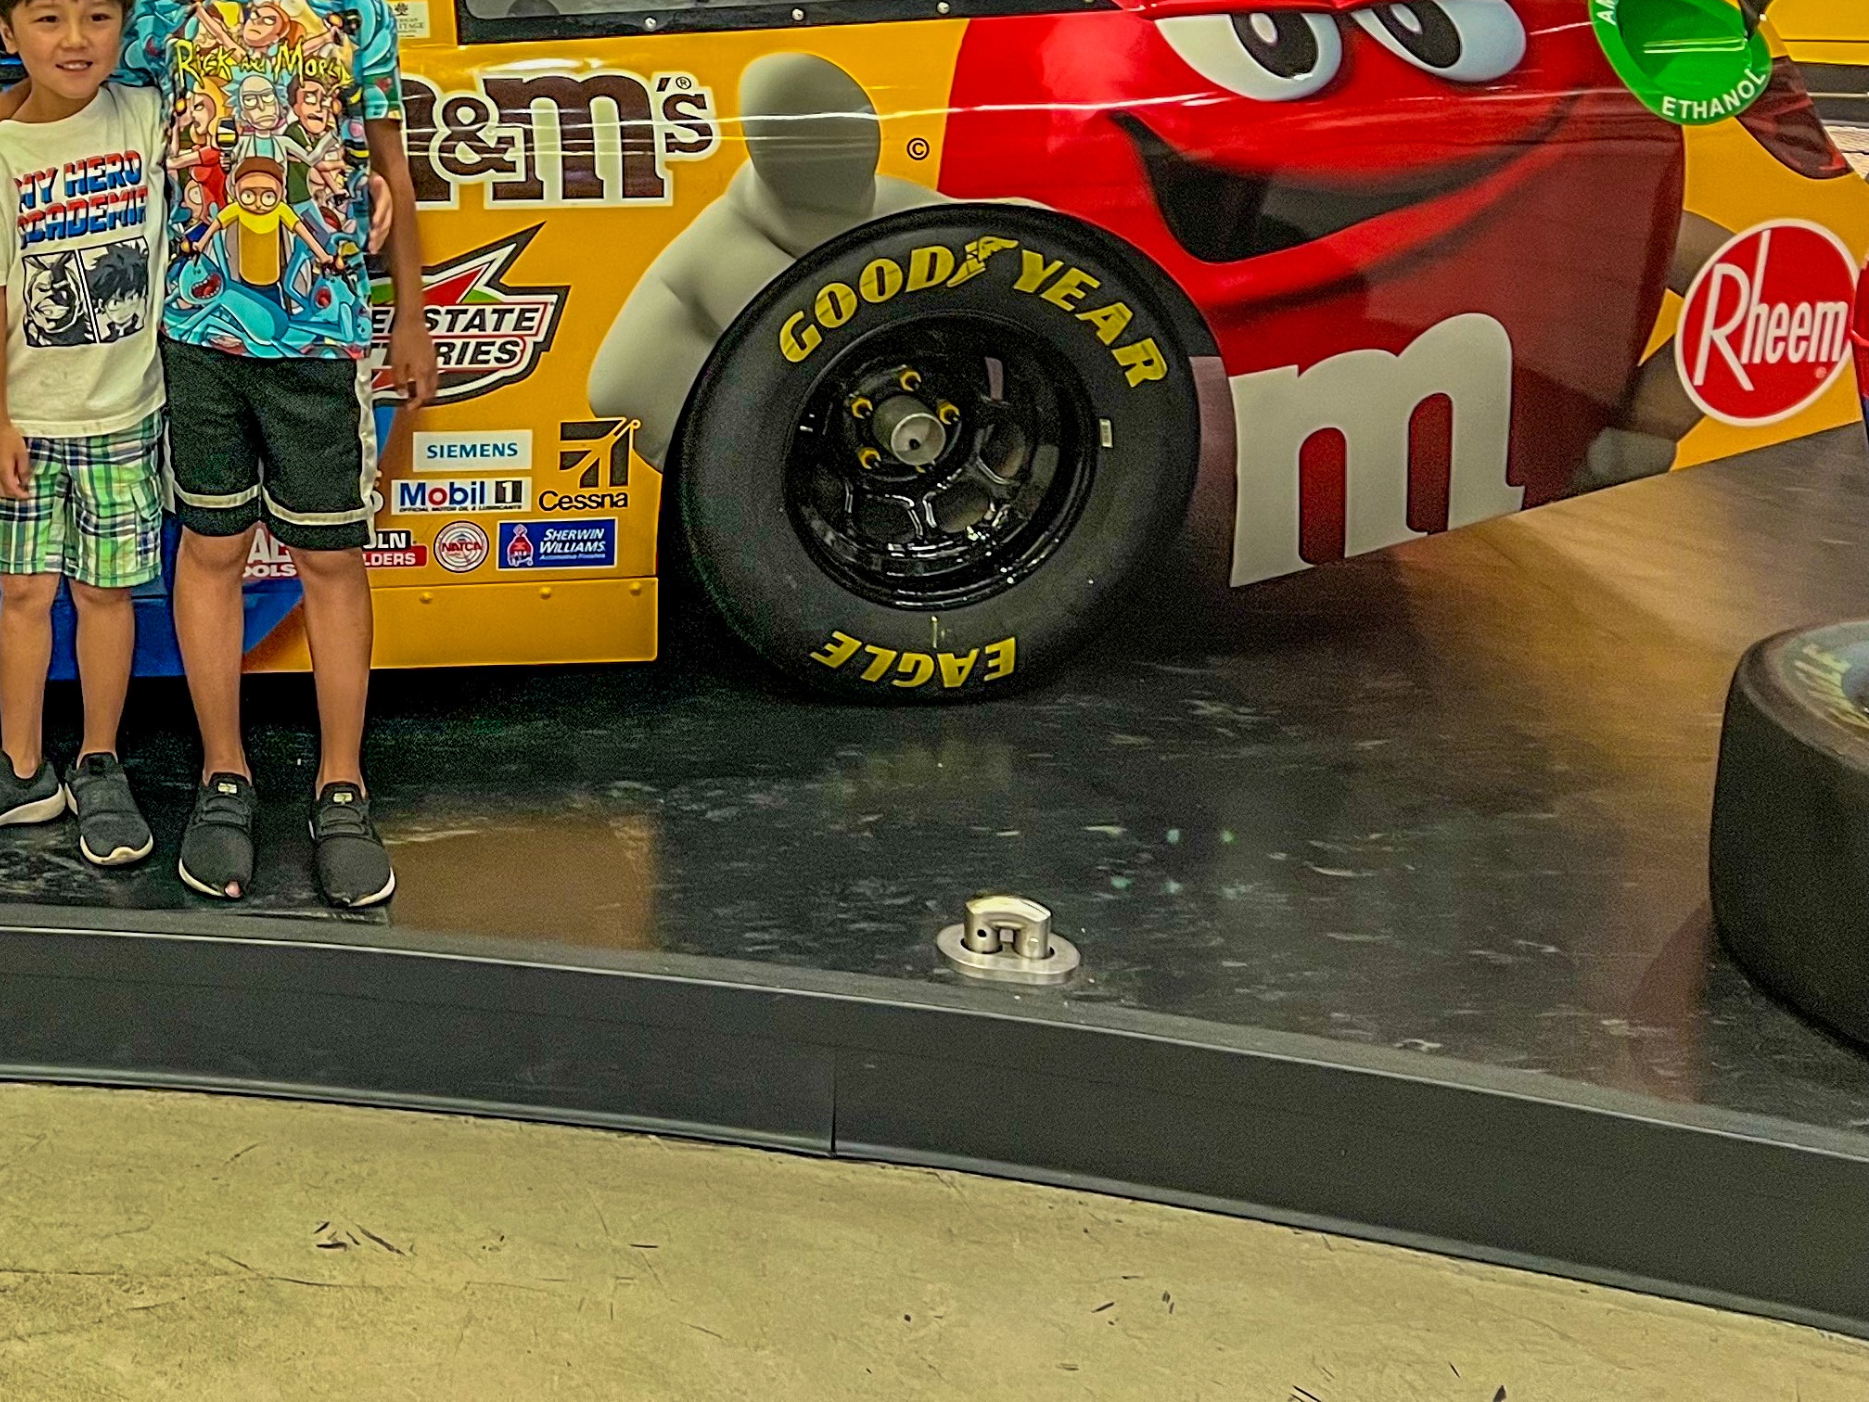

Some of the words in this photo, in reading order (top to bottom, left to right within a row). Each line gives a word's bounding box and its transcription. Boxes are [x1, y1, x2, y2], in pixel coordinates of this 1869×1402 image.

[1662, 68, 1766, 120] ETHANOL
[63, 150, 142, 198] HERO
[1693, 229, 1848, 391] Rheem
[426, 442, 518, 459] SIEMENS
[399, 481, 485, 507] Mobil
[539, 490, 628, 511] Cessna
[539, 541, 607, 554] WILLIAMS
[543, 528, 605, 541] SHERWIN
[811, 629, 1018, 688] EAGLE
